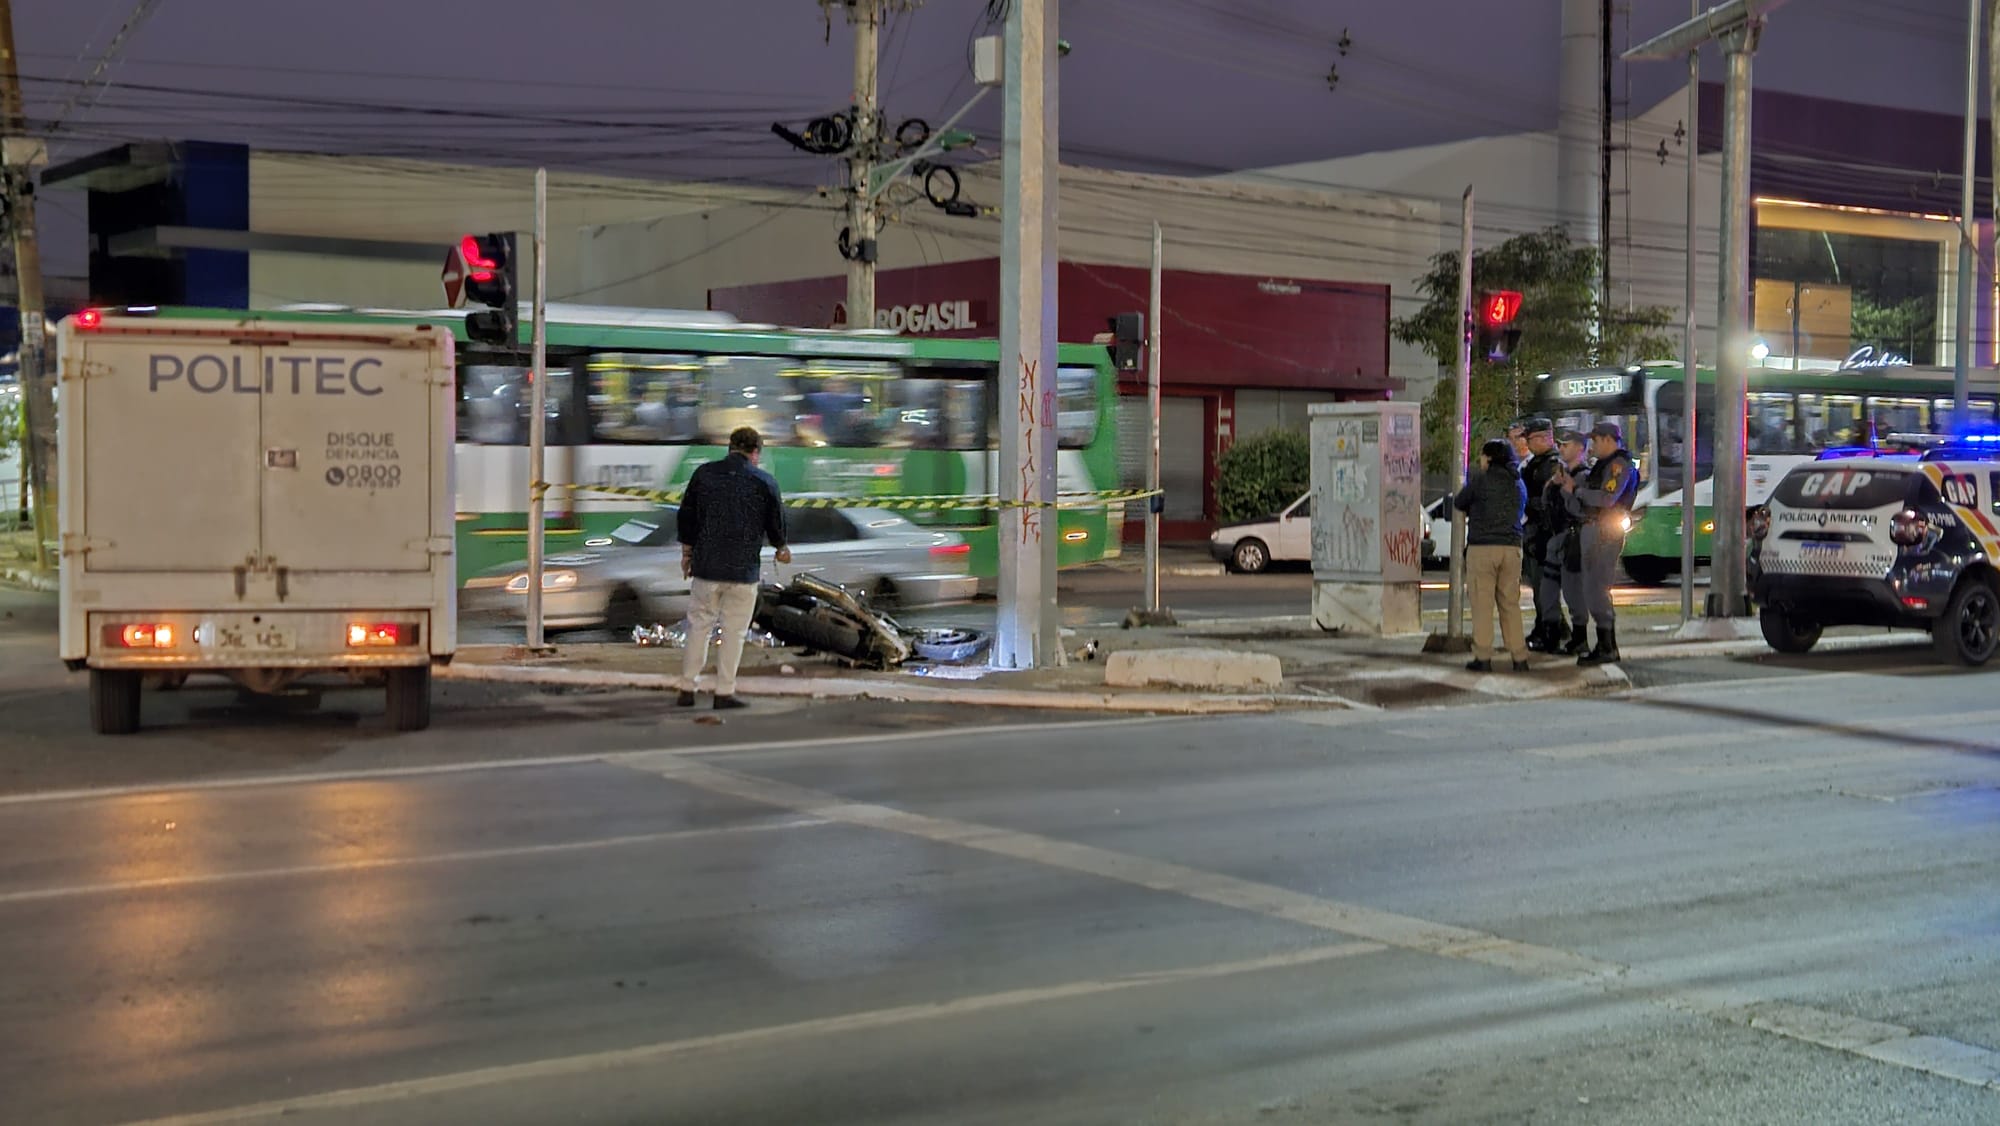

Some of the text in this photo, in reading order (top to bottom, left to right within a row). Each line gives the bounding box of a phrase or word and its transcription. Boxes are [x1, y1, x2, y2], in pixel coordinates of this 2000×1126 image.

[875, 300, 977, 334] ROGASIL
[149, 354, 384, 396] POLITEC
[327, 431, 395, 448] DISQUE
[345, 464, 401, 480] 0800
[1801, 471, 1873, 497] GAP
[1945, 480, 1976, 505] GAP
[1829, 511, 1878, 524] MILITAR
